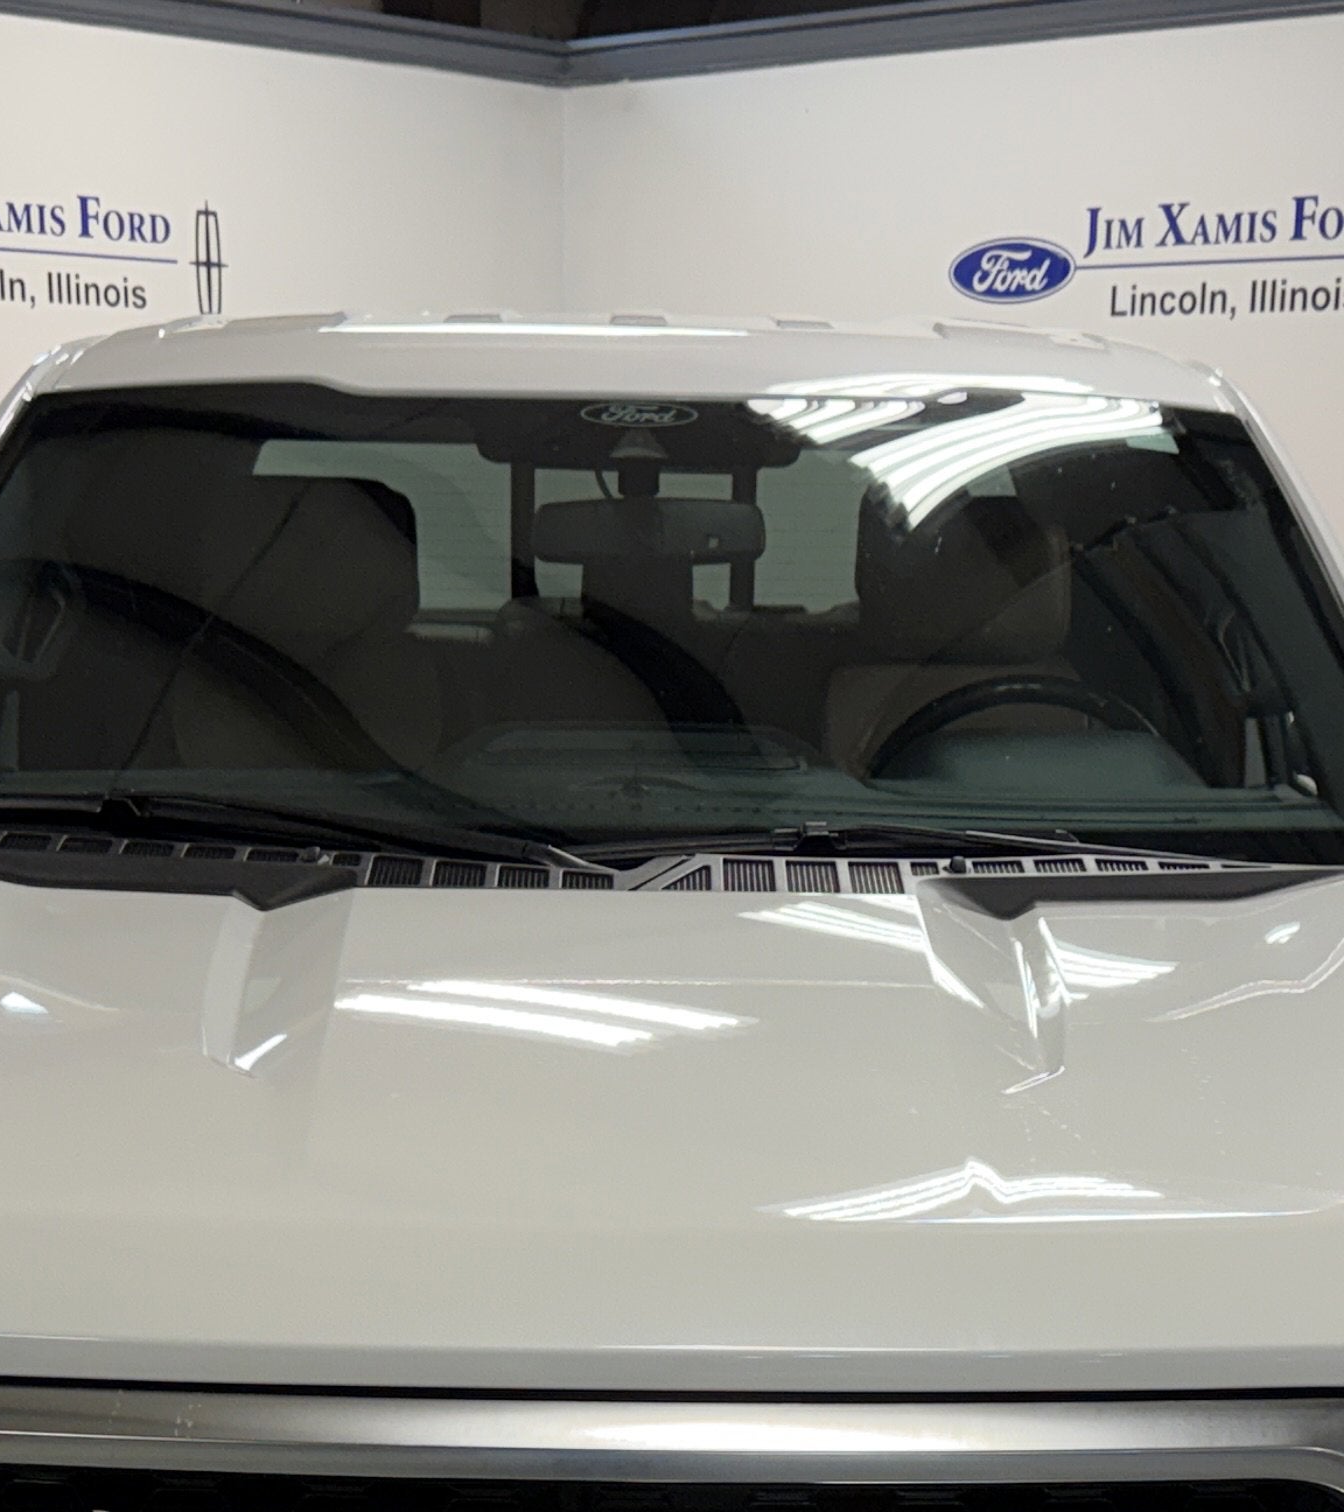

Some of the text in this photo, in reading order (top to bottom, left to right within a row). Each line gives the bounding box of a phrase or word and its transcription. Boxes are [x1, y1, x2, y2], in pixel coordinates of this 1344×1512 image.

[972, 249, 1048, 293] Ford
[46, 271, 148, 310] Illinois
[1110, 282, 1236, 320] Lincoln,
[601, 403, 676, 423] Ford
